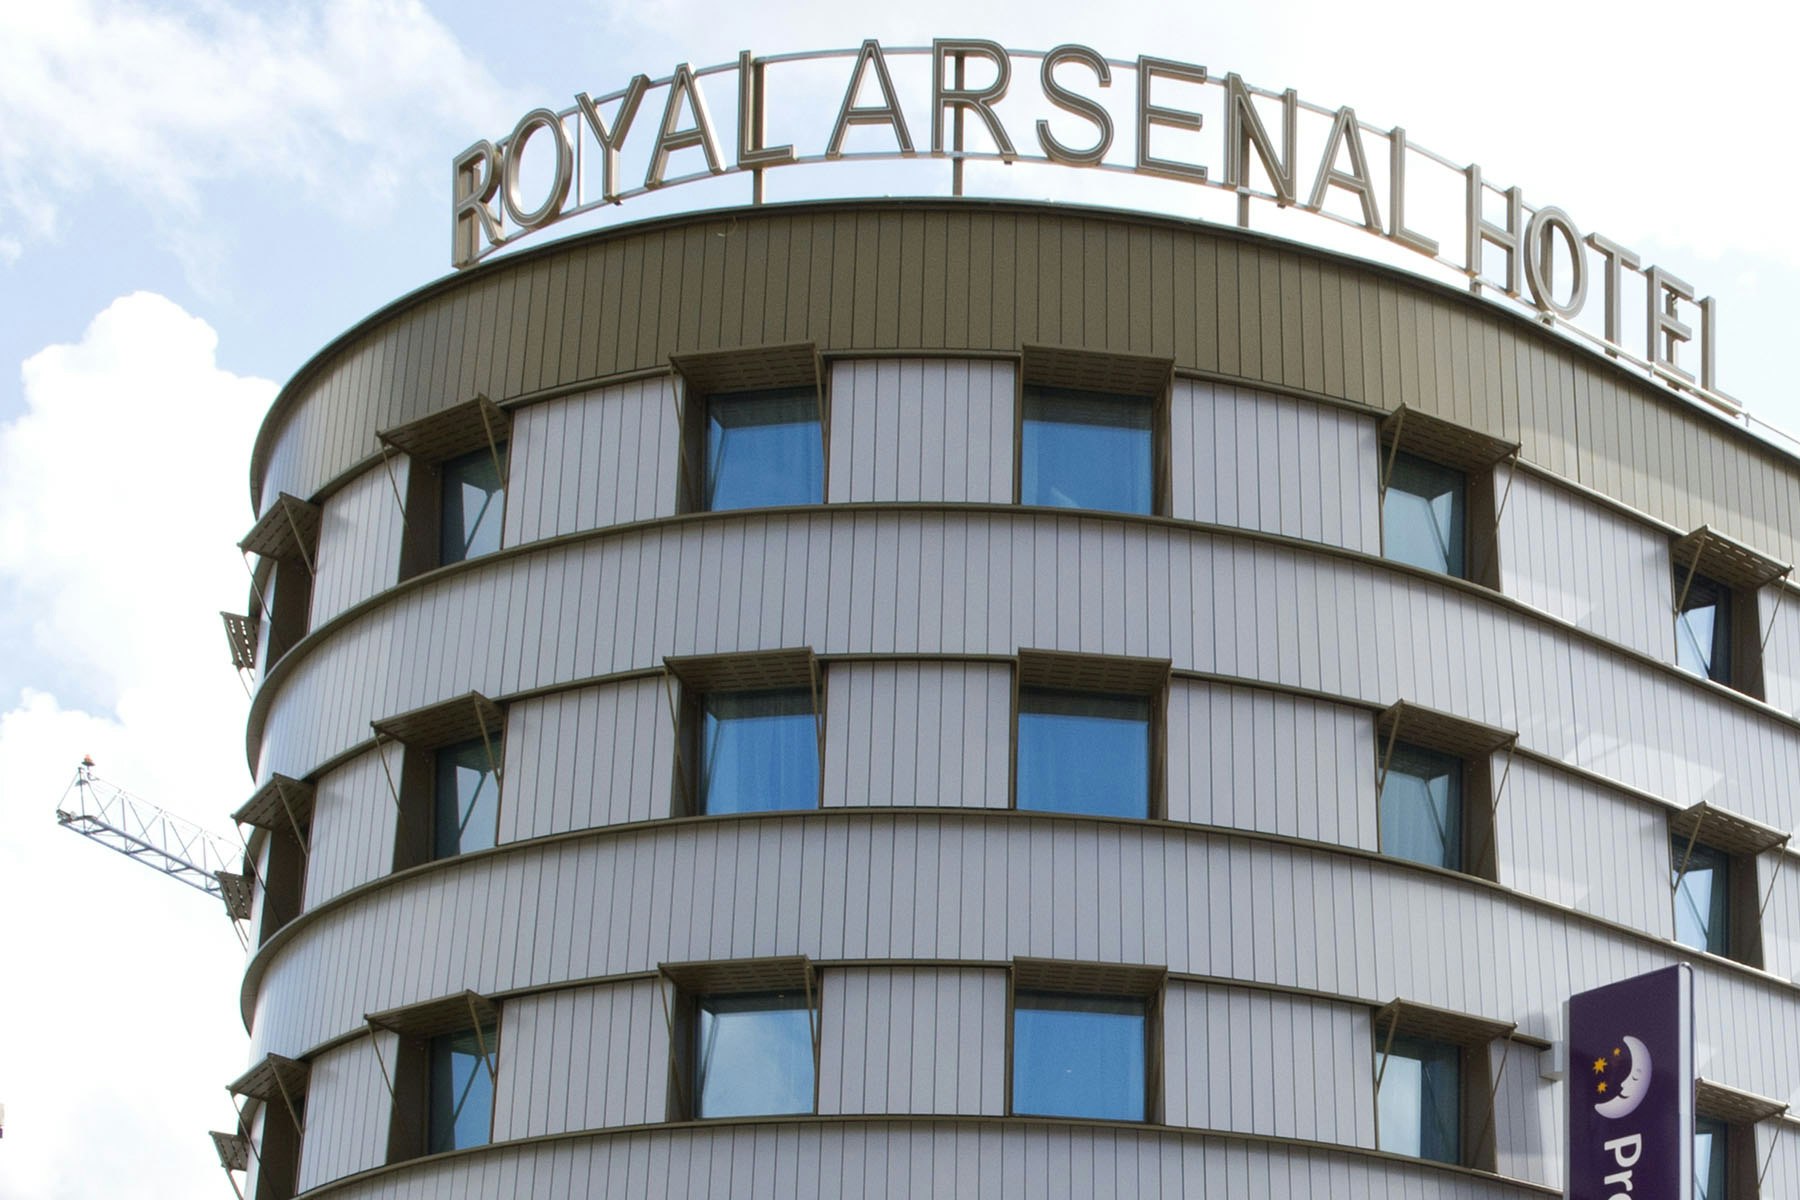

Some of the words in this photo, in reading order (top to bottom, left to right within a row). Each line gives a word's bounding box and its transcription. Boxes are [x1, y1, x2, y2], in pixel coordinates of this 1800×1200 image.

[451, 50, 798, 271] ROYAL
[825, 38, 1439, 257] ARSENAL
[1465, 162, 1742, 418] HOTEL
